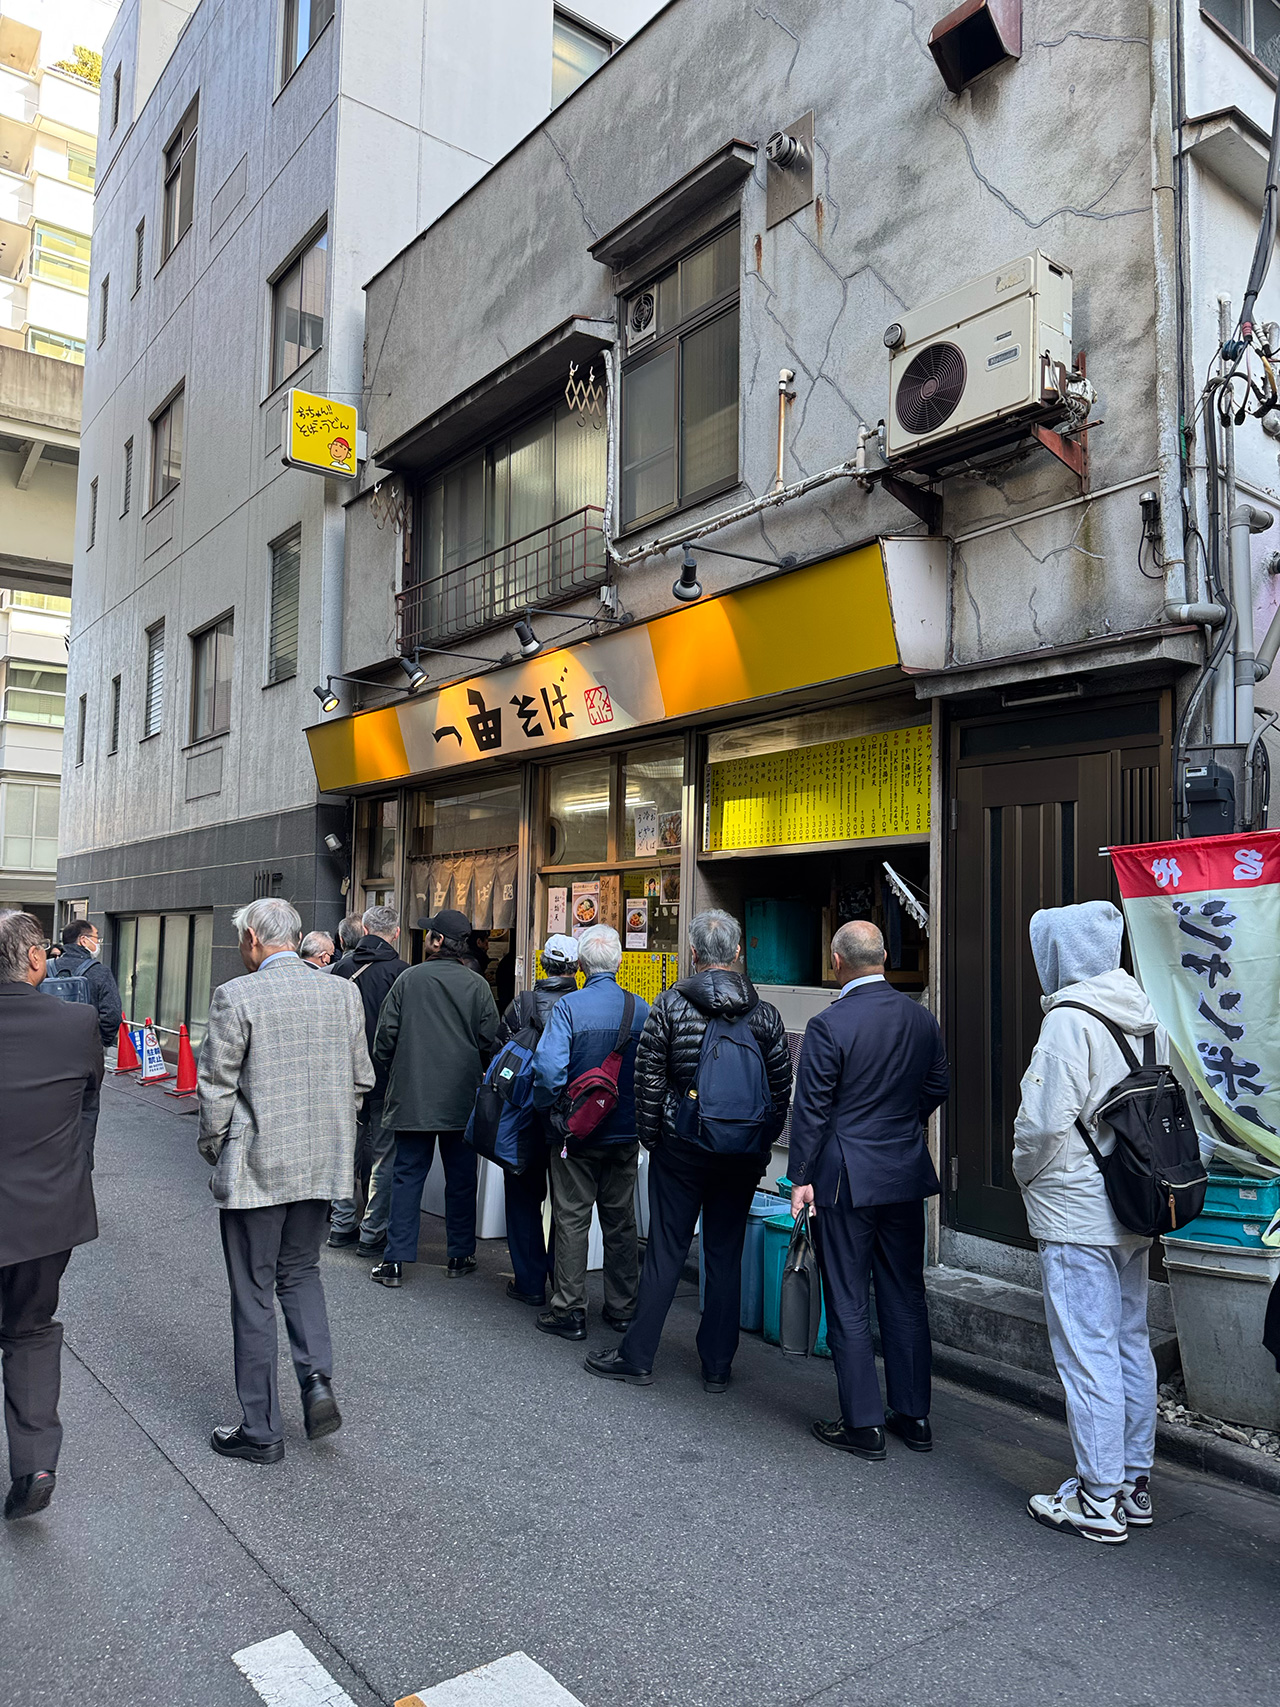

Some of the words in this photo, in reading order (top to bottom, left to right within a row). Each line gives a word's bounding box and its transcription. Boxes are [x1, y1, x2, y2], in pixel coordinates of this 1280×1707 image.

[296, 417, 349, 437] そば・うどん
[432, 667, 574, 751] 一由そば
[416, 881, 492, 907] 一由そば
